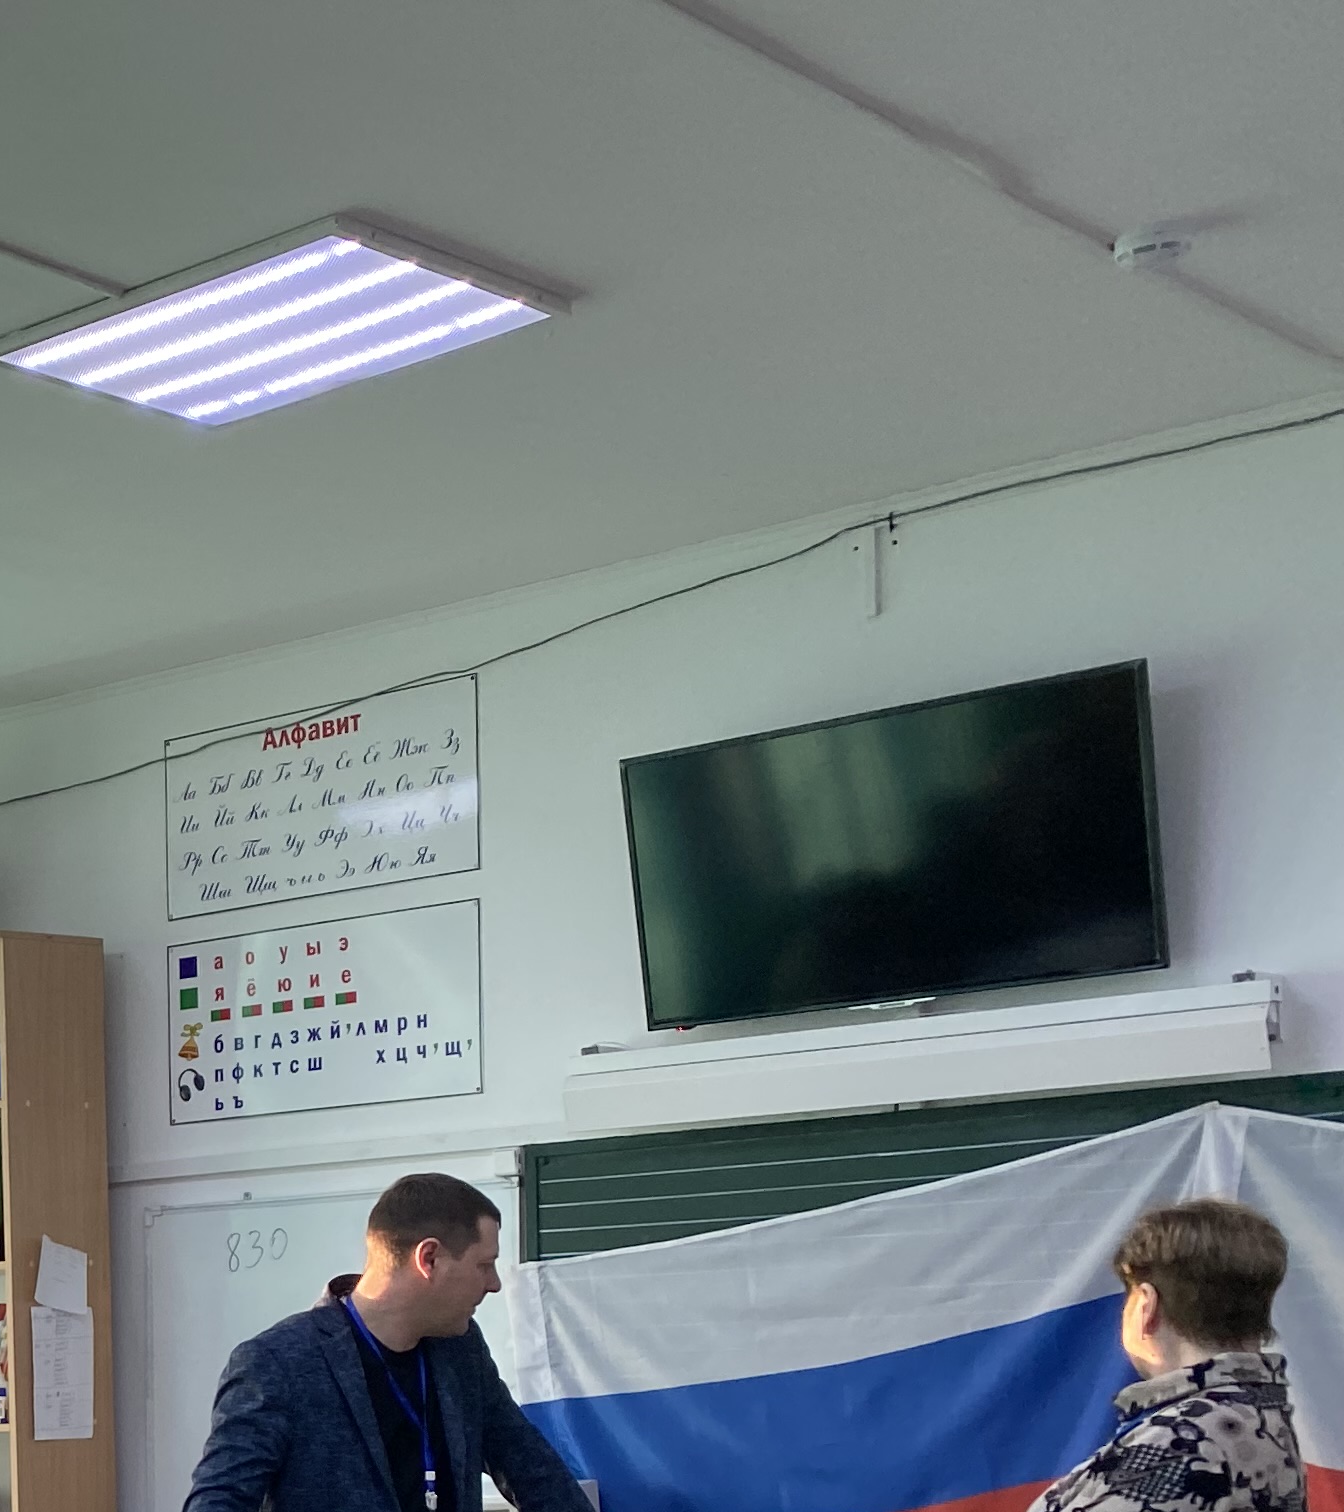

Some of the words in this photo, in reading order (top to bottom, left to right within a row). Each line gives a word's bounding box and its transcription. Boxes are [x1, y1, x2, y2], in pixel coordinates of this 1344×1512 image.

[262, 713, 361, 751] Алфавит
[209, 773, 235, 795] Бб
[240, 769, 263, 789] Вв
[441, 728, 460, 755] Зз
[180, 815, 200, 834] Ии
[214, 804, 235, 828] Йй
[245, 802, 270, 822] Кк
[396, 773, 414, 793] Оо
[424, 764, 455, 788] Пп
[178, 851, 203, 876] Рр
[212, 846, 228, 864] Сс
[235, 838, 271, 860] Тт
[281, 833, 305, 857] Уу
[314, 824, 348, 850] Фф
[364, 852, 401, 874] Юю
[409, 846, 436, 866] Яя
[214, 956, 224, 970] а
[245, 951, 255, 965] о
[278, 945, 288, 964] у
[306, 941, 321, 956] ы
[339, 937, 349, 951] э
[214, 987, 225, 1002] я
[247, 977, 256, 997] ё
[277, 977, 292, 992] ю
[309, 973, 320, 988] и
[341, 969, 351, 984] е
[214, 1033, 224, 1054] б
[234, 1037, 244, 1051] в
[254, 1034, 262, 1049] г
[271, 1032, 283, 1050] д
[290, 1030, 299, 1044] з
[307, 1027, 322, 1042] ж
[355, 1021, 366, 1036] л
[374, 1019, 388, 1034] м
[397, 1016, 408, 1035] р
[417, 1013, 428, 1029] н
[214, 1068, 224, 1083] п
[232, 1062, 244, 1084] ф
[253, 1064, 263, 1078] к
[272, 1061, 282, 1076] т
[290, 1059, 299, 1074] с
[308, 1056, 323, 1072] ш
[376, 1049, 386, 1064] х
[396, 1047, 408, 1064] ц
[215, 1097, 224, 1111] ь
[232, 1095, 244, 1109] ъ
[227, 1228, 288, 1273] 830
